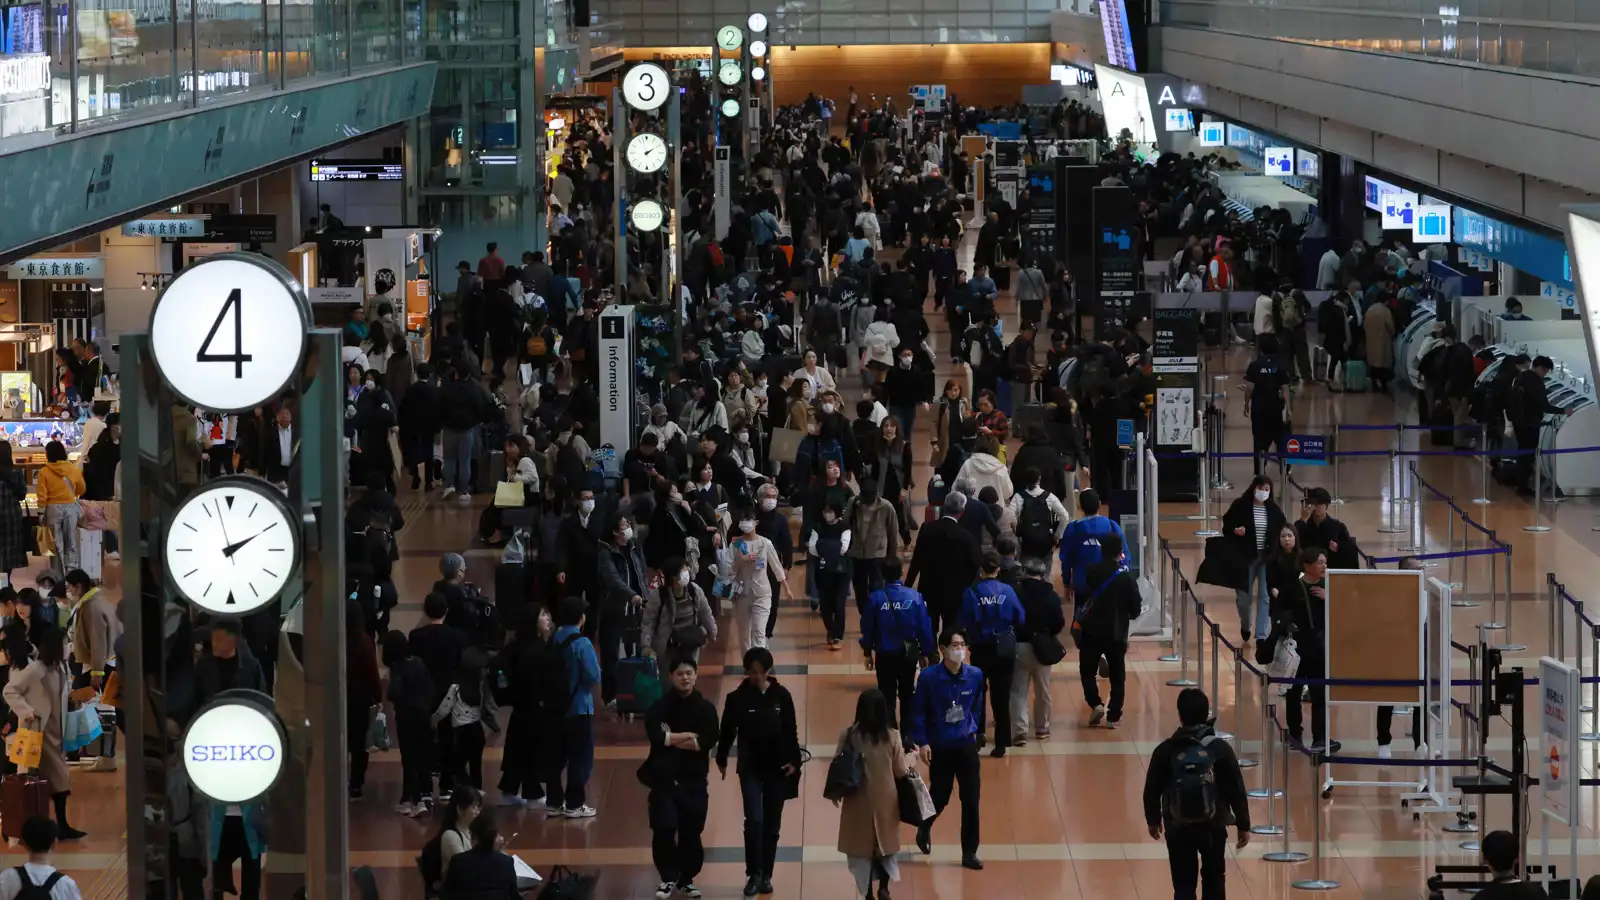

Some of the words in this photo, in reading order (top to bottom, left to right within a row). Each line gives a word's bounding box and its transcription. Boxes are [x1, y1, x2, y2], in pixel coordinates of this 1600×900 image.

[726, 30, 735, 46] 2
[638, 72, 655, 101] 3
[1111, 82, 1125, 96] A
[1157, 85, 1176, 105] A
[1472, 254, 1478, 265] 2
[1482, 258, 1488, 270] 3
[1544, 286, 1552, 297] 4
[1566, 295, 1574, 307] 6
[196, 287, 253, 379] 4
[609, 346, 619, 412] Information
[191, 744, 275, 762] SEIKO
